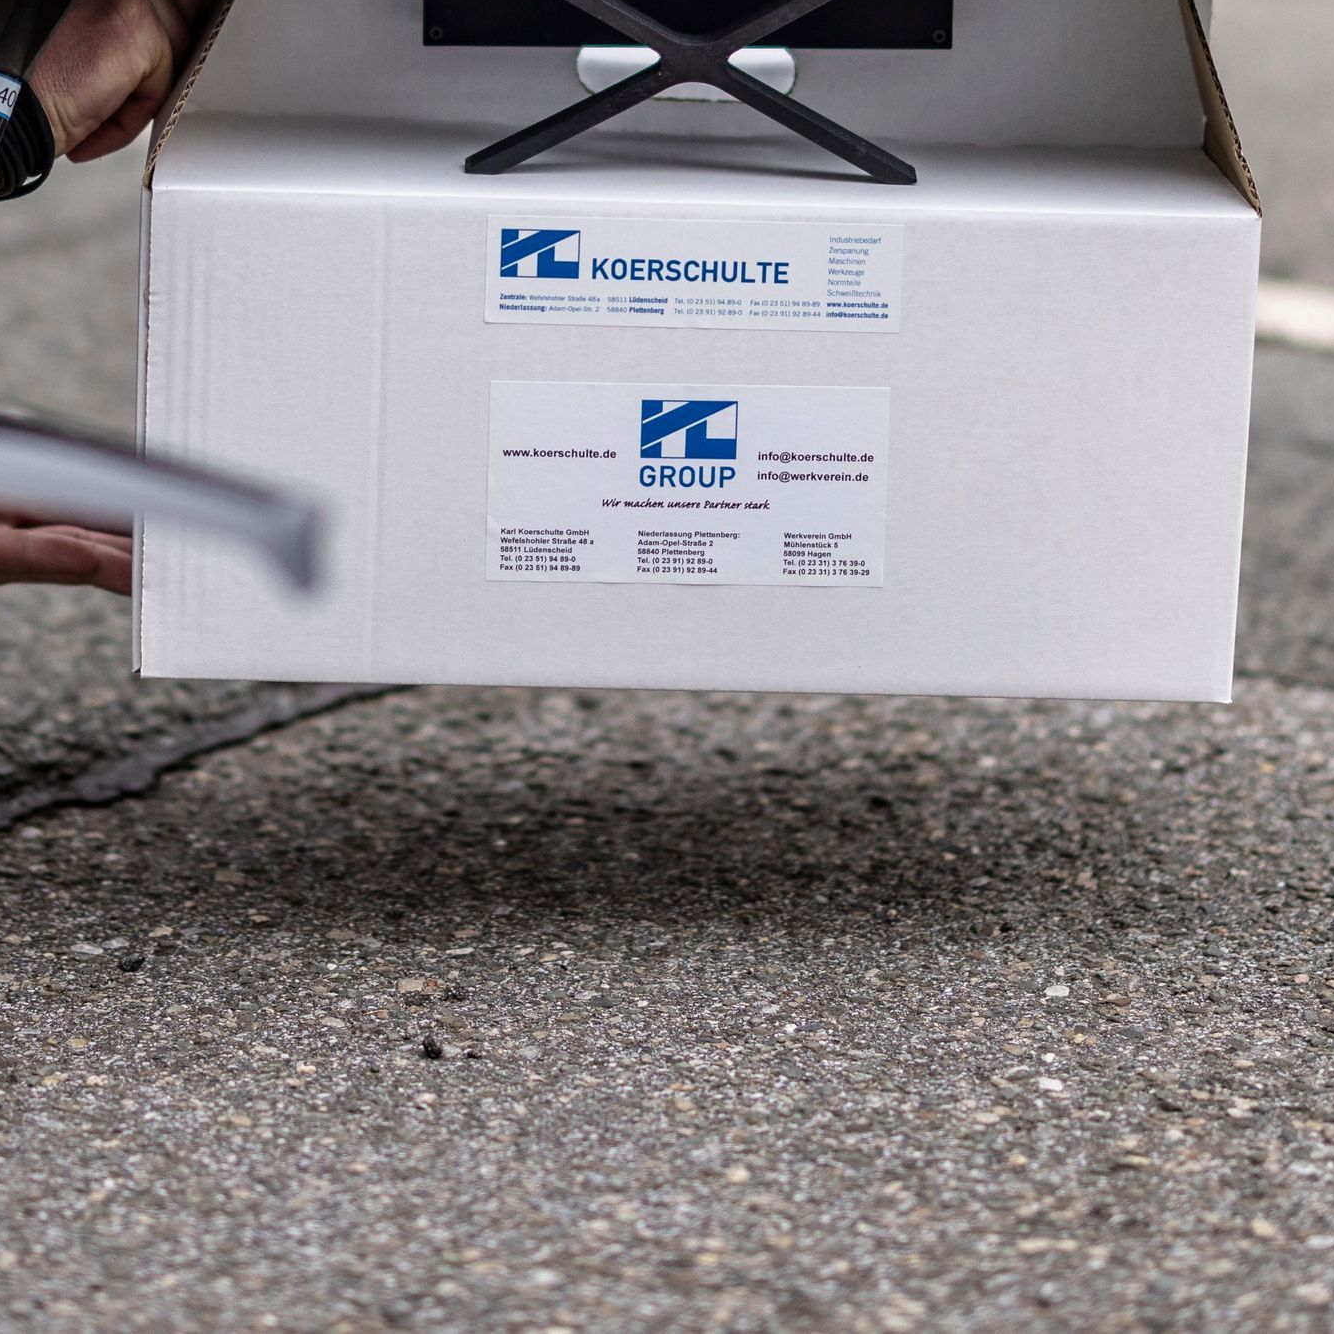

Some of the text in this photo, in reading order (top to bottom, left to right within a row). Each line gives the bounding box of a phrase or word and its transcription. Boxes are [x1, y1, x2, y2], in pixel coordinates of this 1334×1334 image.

[829, 236, 881, 244] Industriebedarf
[828, 246, 869, 256] Zerspanung
[828, 257, 866, 265] Maschinen
[590, 257, 790, 285] KOERSCHULTE
[827, 268, 865, 277] Werkzeuge
[827, 279, 861, 287] Normteile
[827, 289, 881, 298] Schweißtechnik
[499, 293, 528, 301] Zentrale:
[529, 294, 566, 302] Wefelshohler
[567, 295, 587, 303] Straße
[629, 296, 668, 304] Lüdenscheid
[686, 298, 694, 306] (0
[705, 298, 716, 306] 51)
[826, 301, 889, 309] www.koerschulte.de
[606, 306, 665, 315] 58840 Plettenberg
[686, 308, 694, 316] (0
[705, 308, 716, 316] 91)
[780, 310, 791, 318] 91)
[825, 311, 889, 319] info@koerschulte.de
[502, 446, 617, 460] www.koerschulte.de
[757, 450, 875, 464] info@koerschulte.de
[639, 464, 736, 489] GROUP
[757, 470, 869, 484] info@werkverein.de
[601, 498, 770, 510] Wir machen unsere Partner stark
[518, 528, 564, 536] Koerschulte
[637, 530, 741, 540] Niederlassung Plettenberg:
[637, 539, 707, 547] Adam-Opel-Straße
[783, 541, 832, 549] Mühlenstück
[661, 548, 705, 557] Plettenberg
[807, 551, 832, 559] Hagen
[515, 555, 523, 563] (0
[535, 555, 547, 563] 51)
[652, 557, 660, 565] (0
[672, 557, 684, 565] 91)
[798, 559, 806, 567] (0
[515, 564, 523, 572] (0
[535, 564, 547, 572] 51)
[652, 566, 660, 574] (0
[672, 566, 684, 574] 91)
[798, 568, 806, 576] (0
